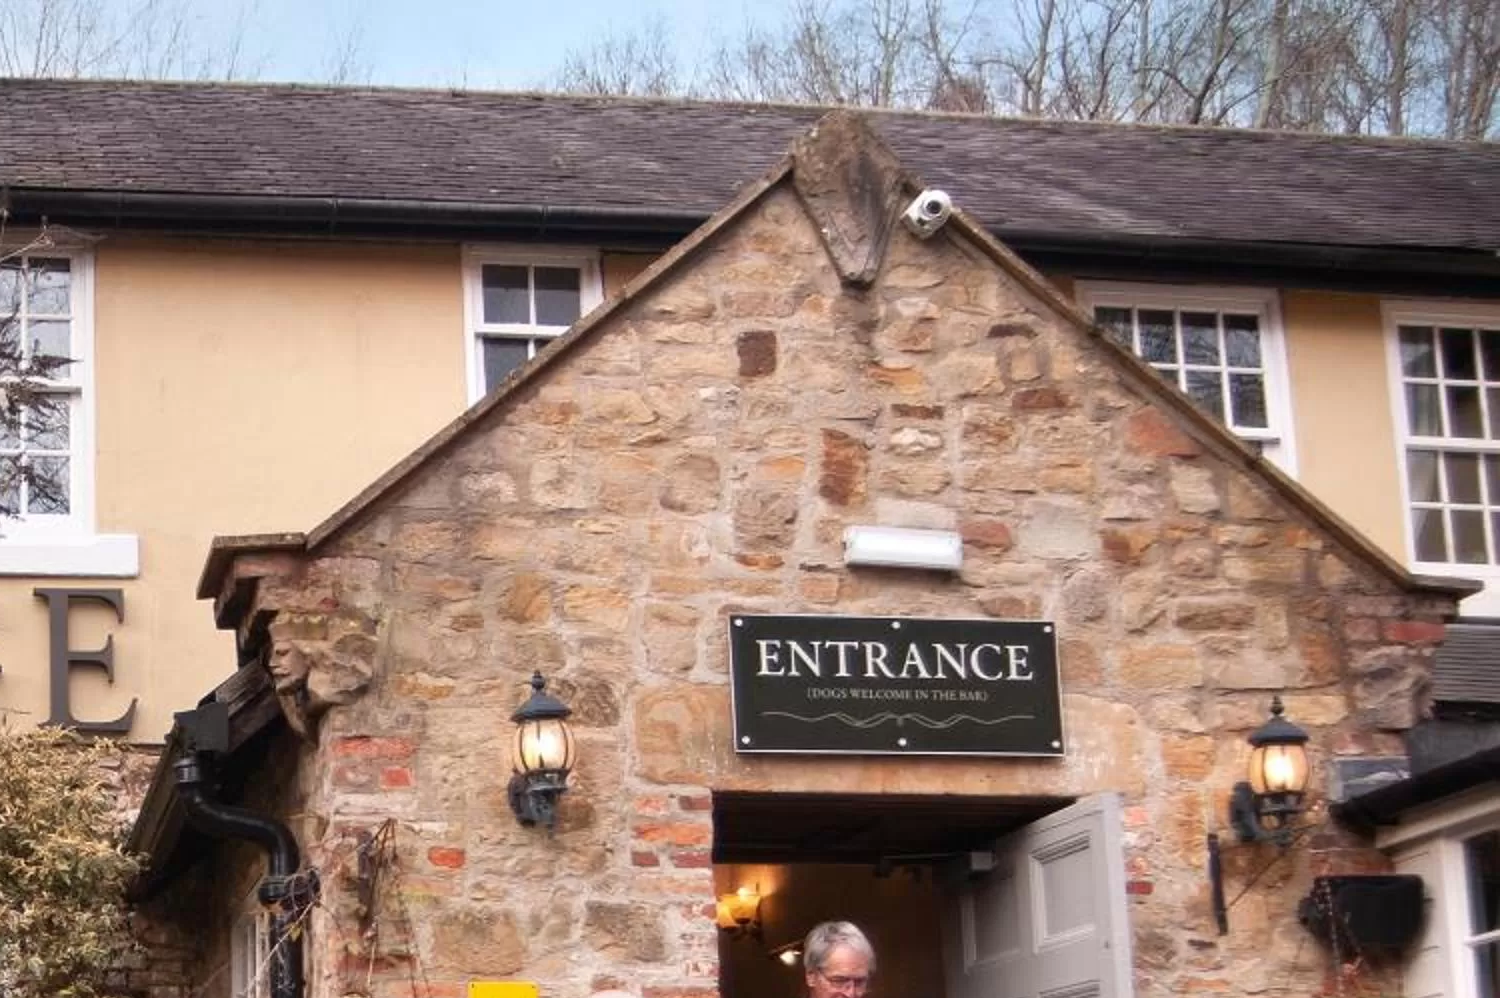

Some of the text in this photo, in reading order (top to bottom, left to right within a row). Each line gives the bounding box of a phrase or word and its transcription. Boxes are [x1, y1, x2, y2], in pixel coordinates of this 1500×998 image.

[755, 639, 1034, 681] ENTRANCE
[807, 687, 989, 702] (DOGS WELCOME IN THE BAR)
